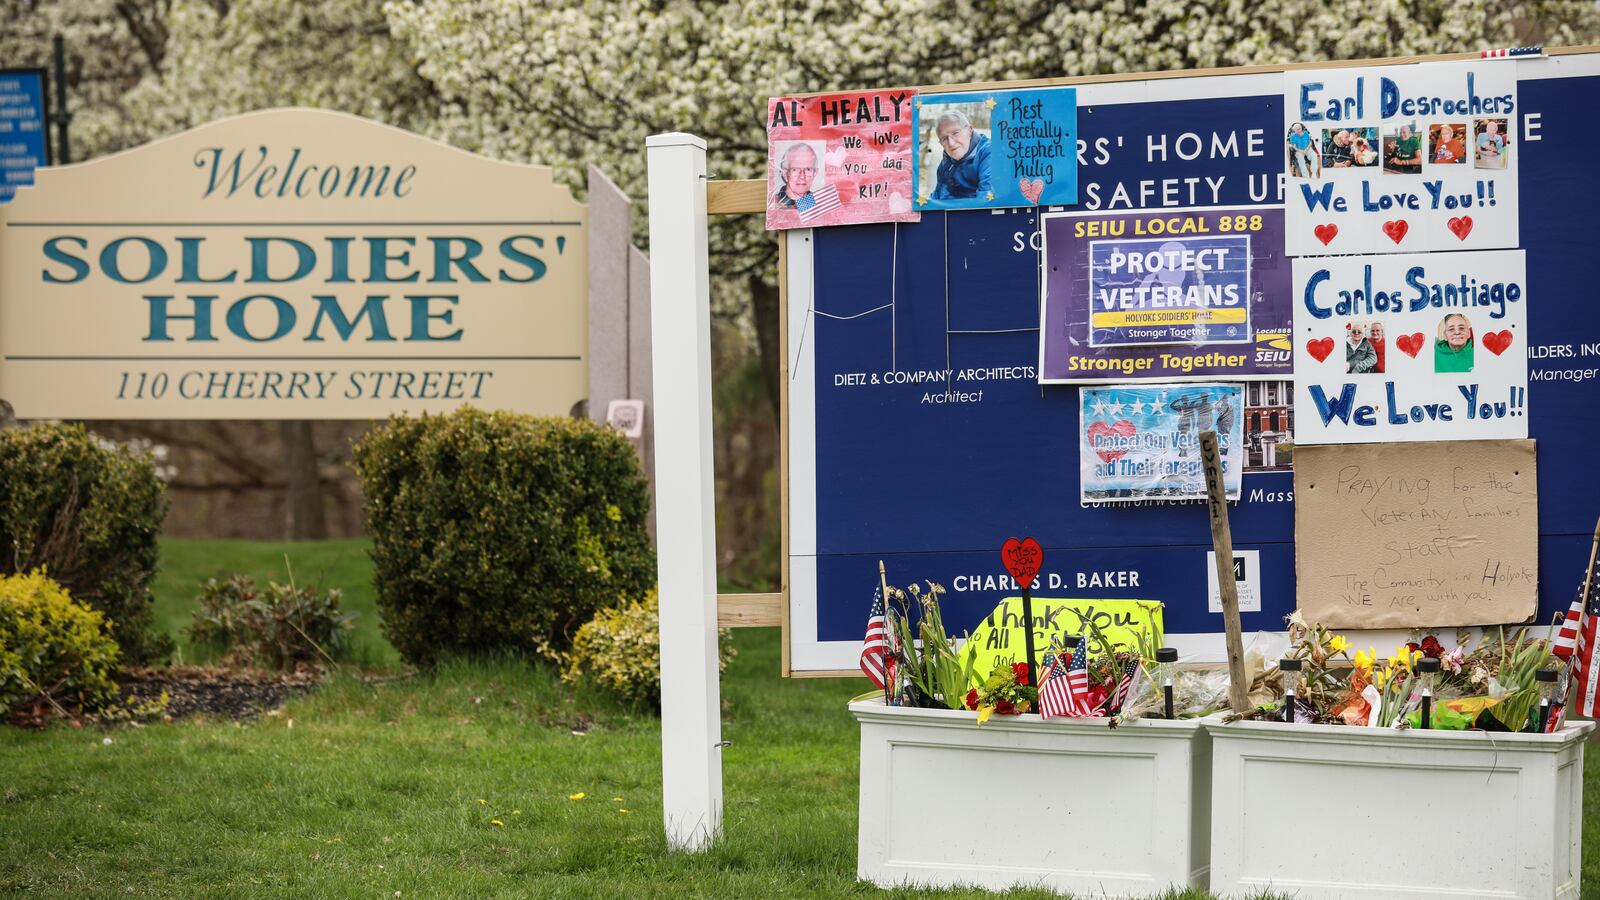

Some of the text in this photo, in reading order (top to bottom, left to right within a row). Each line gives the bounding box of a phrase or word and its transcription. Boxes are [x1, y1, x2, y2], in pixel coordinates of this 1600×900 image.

[1300, 72, 1514, 122] Earl Desrochers
[772, 92, 906, 128] AL HEALY
[1008, 97, 1044, 124] Rest
[843, 136, 862, 149] We
[1006, 140, 1065, 165] Stephen
[1147, 128, 1265, 162] HOME
[193, 145, 417, 200] Welcome
[883, 157, 903, 170] dad
[1013, 160, 1054, 185] Kulig
[859, 182, 888, 199] RIP!
[1084, 175, 1226, 211] SAFETY
[1300, 181, 1348, 214] We
[1362, 180, 1420, 212] Love
[1422, 180, 1497, 210] You!!
[1074, 215, 1263, 238] SEIU LOCAL 888
[41, 235, 567, 284] SOLDIERS'
[1110, 248, 1230, 274] PROTECT
[1100, 283, 1240, 310] VETERANS
[1304, 264, 1522, 320] Carlos Santiago
[142, 294, 464, 341] HOME
[1125, 313, 1156, 323] HOLYOKE
[1128, 327, 1211, 339] Stronger Together
[1068, 353, 1247, 374] Stronger Together
[1255, 351, 1291, 362] SEIU
[1528, 344, 1577, 359] ILDERS,
[116, 371, 494, 399] 110 CHERRY STREET
[834, 366, 1039, 386] DIETZ & COMPANY ARCHITECTS,
[1530, 368, 1599, 383] Manager
[921, 390, 984, 404] Architect
[1308, 381, 1525, 428] We Love You!!
[1094, 433, 1140, 449] Protect
[1171, 431, 1229, 450] Vetens
[1120, 458, 1154, 477] Their
[953, 571, 1140, 593] CHARLS D. BAKER
[1010, 567, 1036, 578] DAD
[1073, 605, 1140, 633] You
[986, 627, 1010, 651] All
